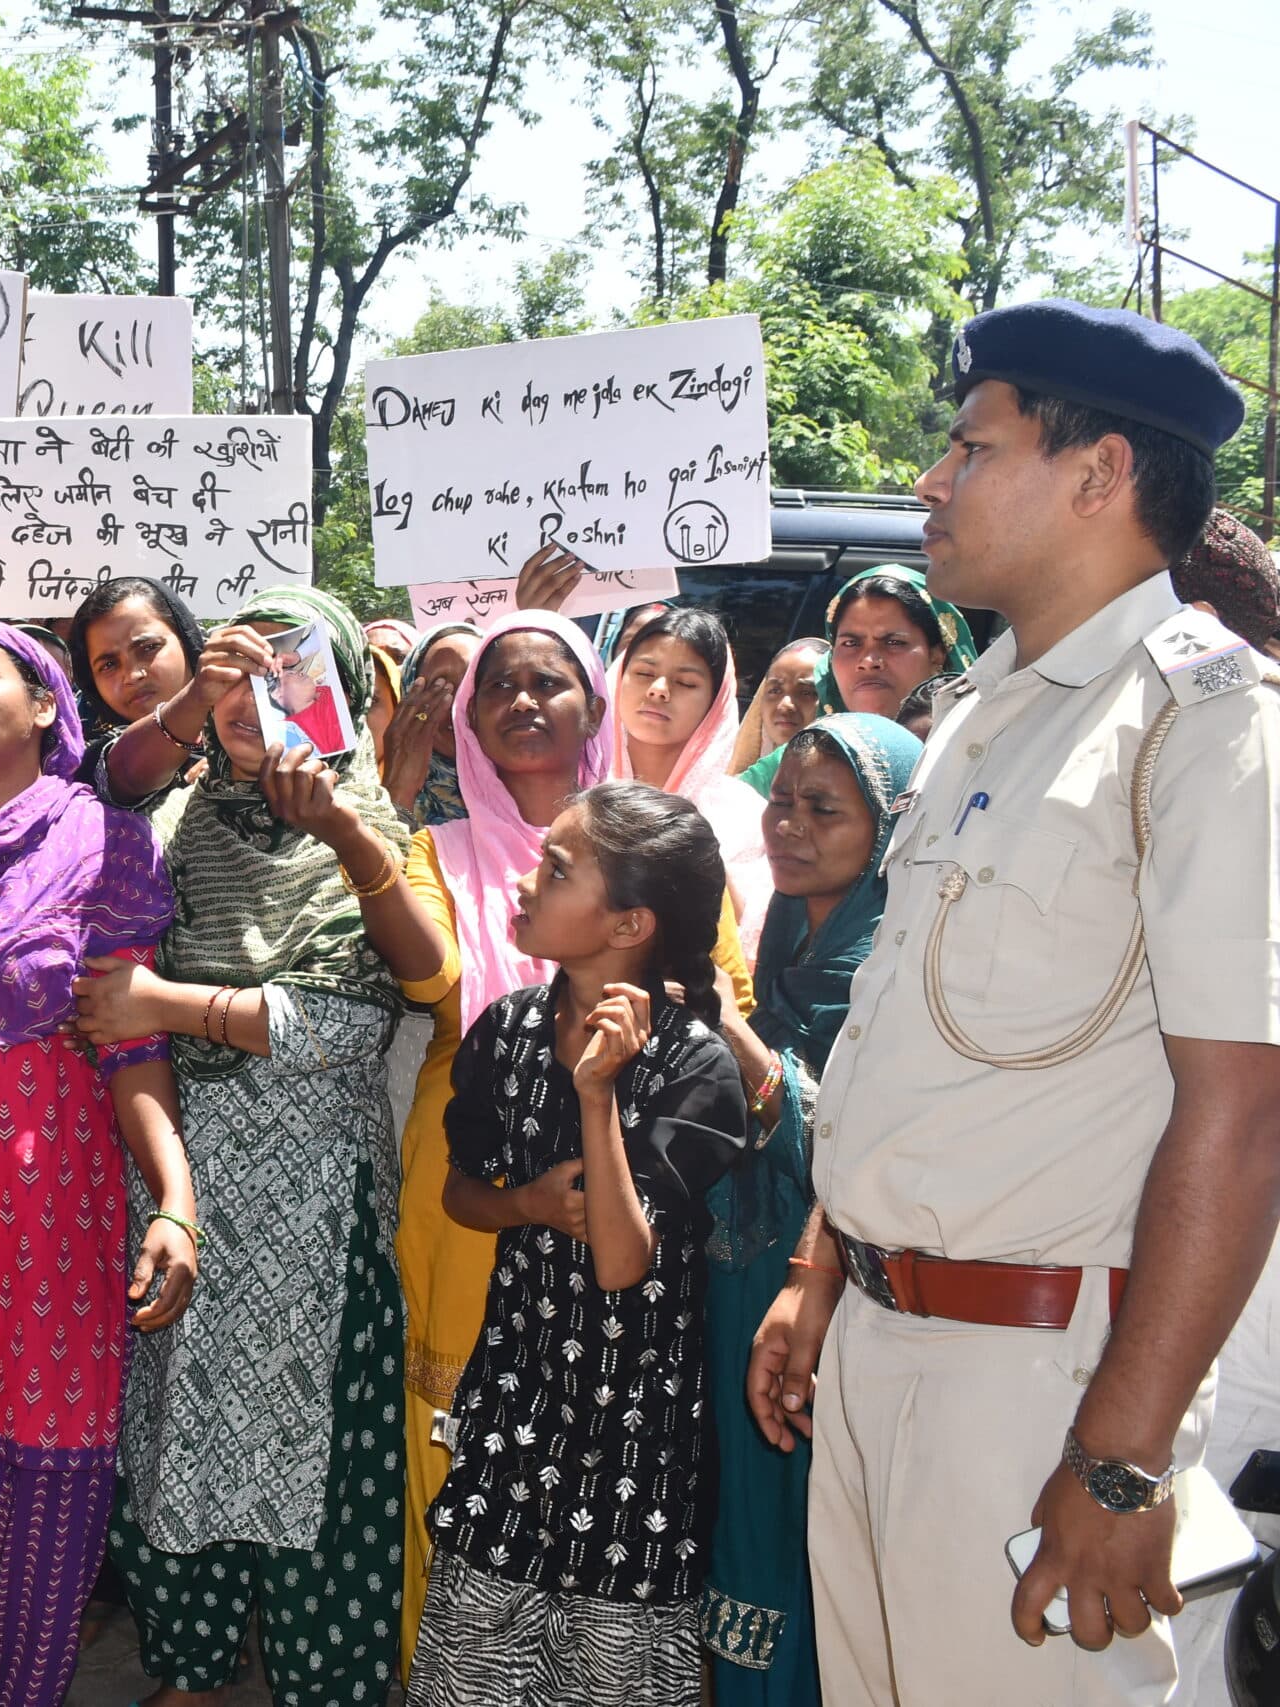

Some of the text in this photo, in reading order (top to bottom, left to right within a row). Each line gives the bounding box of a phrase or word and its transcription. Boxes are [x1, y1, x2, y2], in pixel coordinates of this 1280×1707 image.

[78, 319, 153, 379] Kill
[669, 362, 753, 415] Zindagi
[35, 426, 75, 465] ने
[89, 424, 135, 463] बेटी
[146, 427, 180, 460] की
[193, 426, 282, 472] खुशियों
[54, 466, 112, 506] जमीन
[132, 474, 179, 509] बेच
[192, 470, 232, 514] दी
[372, 478, 413, 530] Log
[431, 486, 473, 515] chup
[543, 460, 610, 516] Khatam
[624, 470, 647, 500] ho
[11, 512, 73, 547] दहेज
[96, 512, 125, 547] की
[135, 520, 189, 561] भूख
[205, 517, 235, 547] ने
[246, 501, 315, 575] रानी
[488, 531, 509, 567] Ki
[419, 595, 458, 617] अब
